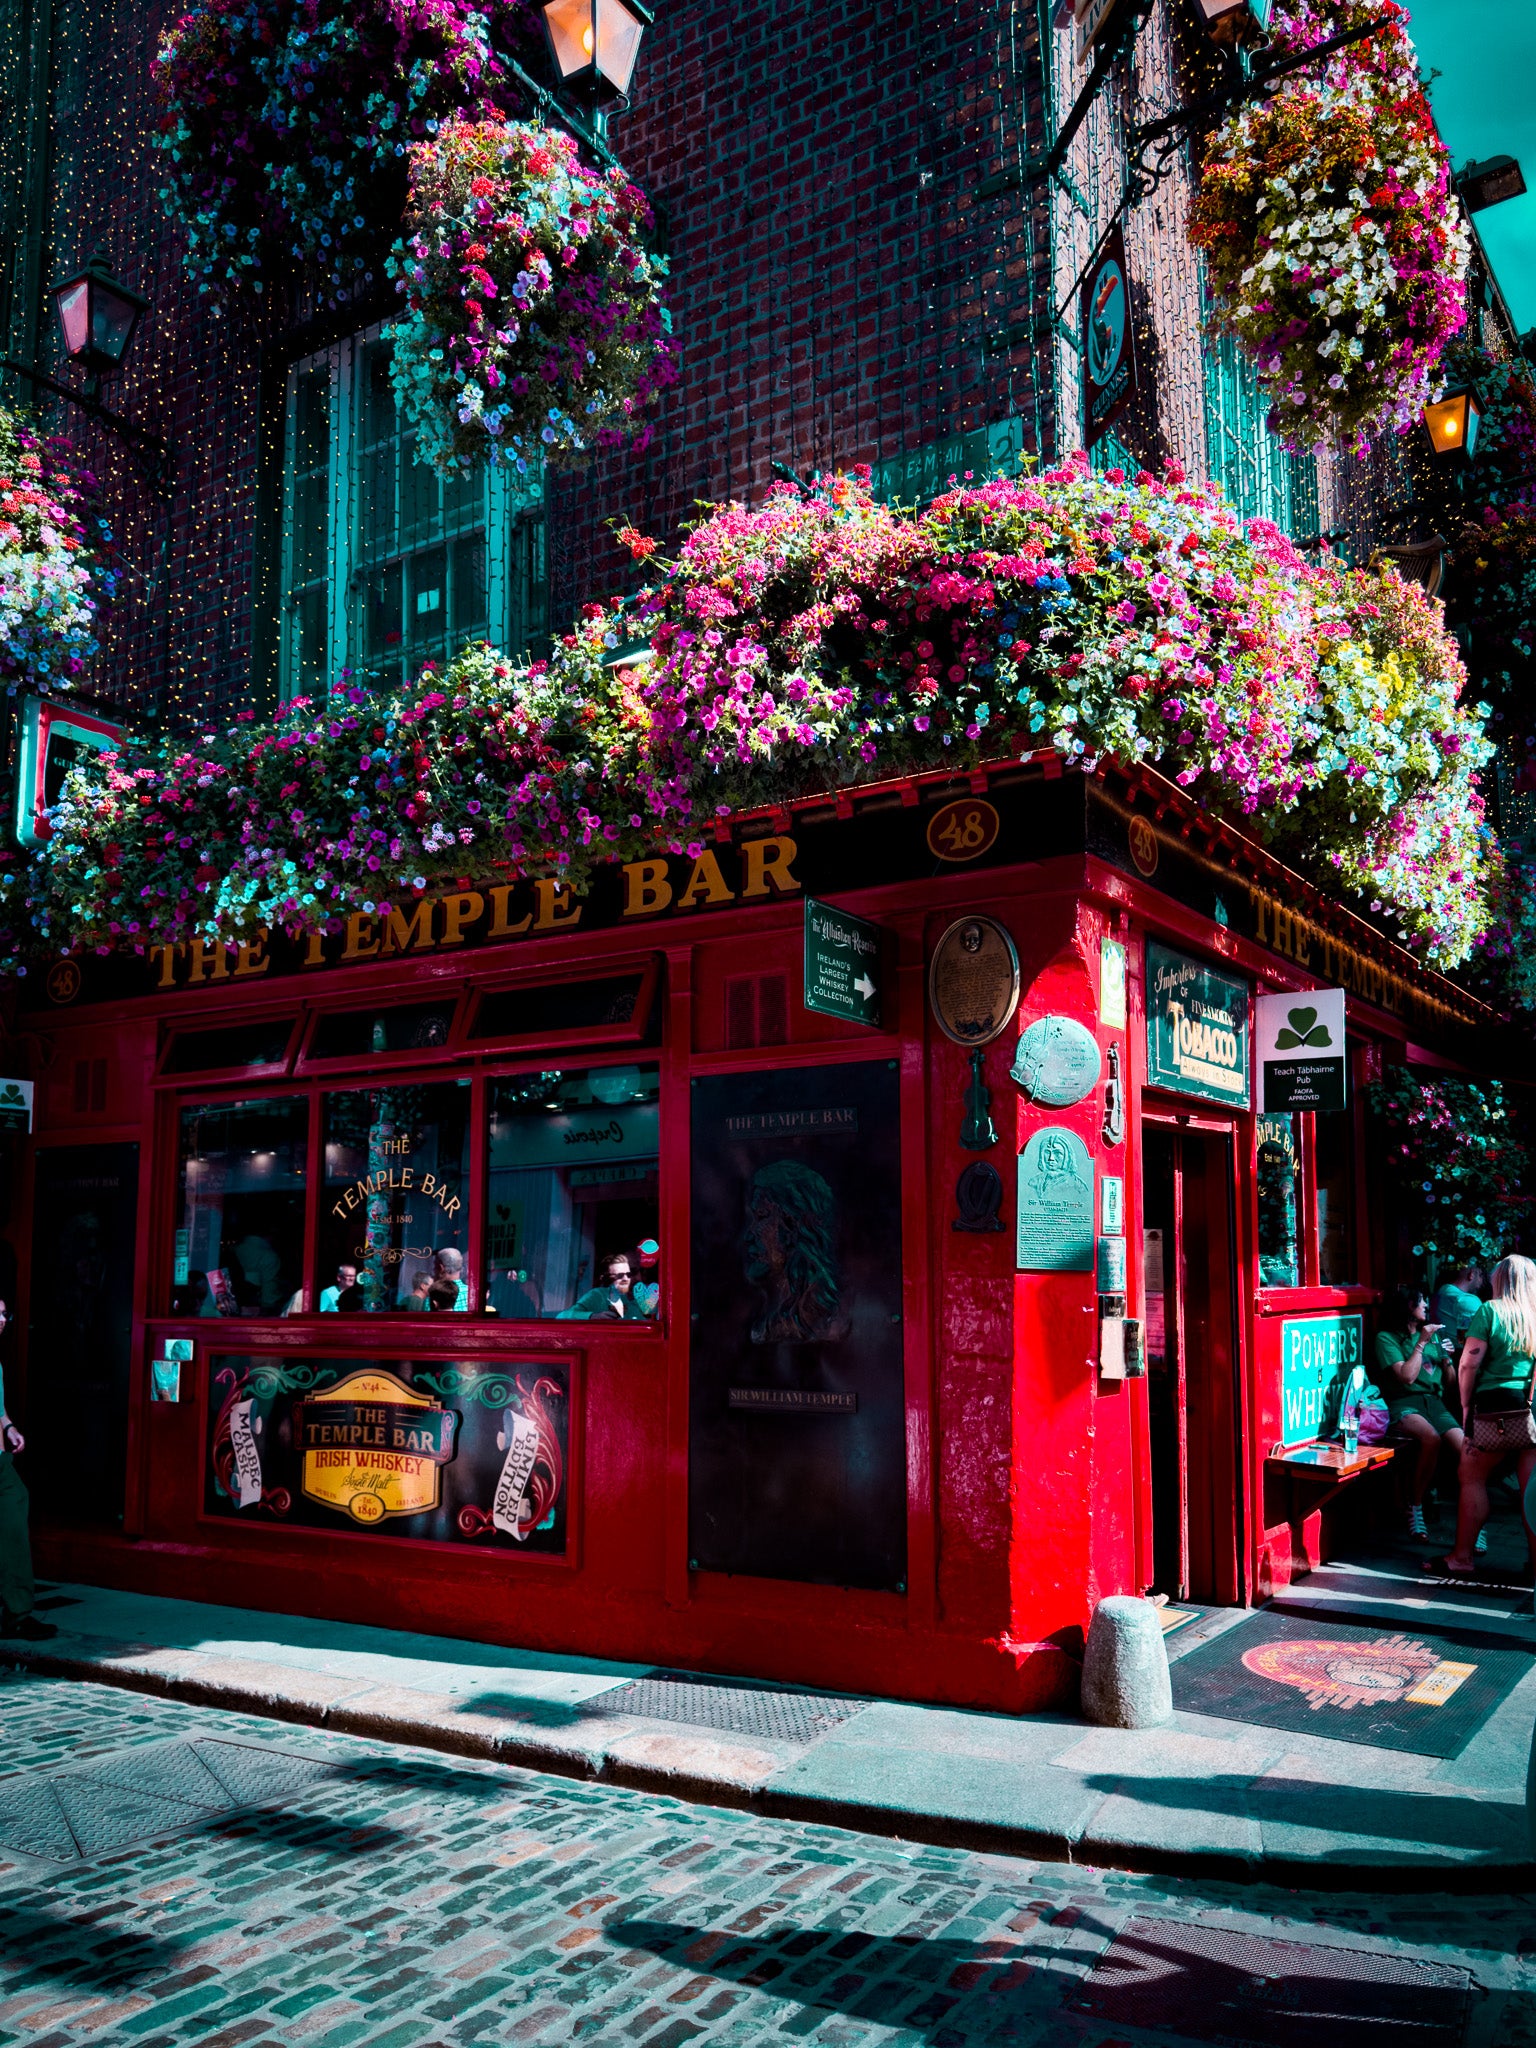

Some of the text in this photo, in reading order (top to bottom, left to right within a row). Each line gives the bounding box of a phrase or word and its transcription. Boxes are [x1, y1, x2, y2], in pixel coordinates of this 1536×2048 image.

[995, 435, 1014, 463] 2
[938, 810, 985, 850] 48
[1133, 822, 1154, 863] 48
[150, 928, 271, 988] THE
[622, 836, 802, 917] BAR
[1250, 890, 1311, 967] THE
[817, 952, 851, 972] IRELAND'S
[819, 965, 849, 981] LARGEST
[51, 968, 74, 998] 48
[818, 976, 849, 993] WHISKEY
[1154, 963, 1197, 998] Importers
[813, 985, 854, 1007] COLLECTION
[1166, 1000, 1237, 1069] TOBACCO
[1274, 1064, 1335, 1076] Teach Tábhairne
[1296, 1075, 1311, 1085] Pub
[1288, 1094, 1320, 1102] APPROVED
[727, 1117, 755, 1131] THE
[823, 1108, 854, 1124] BAR
[383, 1139, 411, 1155] THE
[1256, 1121, 1282, 1153] MPLE
[331, 1166, 461, 1221] TEMPLE BAR
[1290, 1327, 1357, 1372] POWER'S
[730, 1390, 853, 1406] SIR WILLIAM TEMPLE
[1286, 1382, 1345, 1431] WHISK
[354, 1407, 387, 1424] THE
[239, 1412, 261, 1489] MALBEC
[306, 1424, 436, 1453] TEMPLE BAR
[232, 1431, 249, 1477] CASK
[315, 1451, 424, 1476] IRISH WHISKEY
[495, 1437, 524, 1517] EDITION
[506, 1431, 537, 1524] LIMITED
[357, 1503, 378, 1517] 1840
